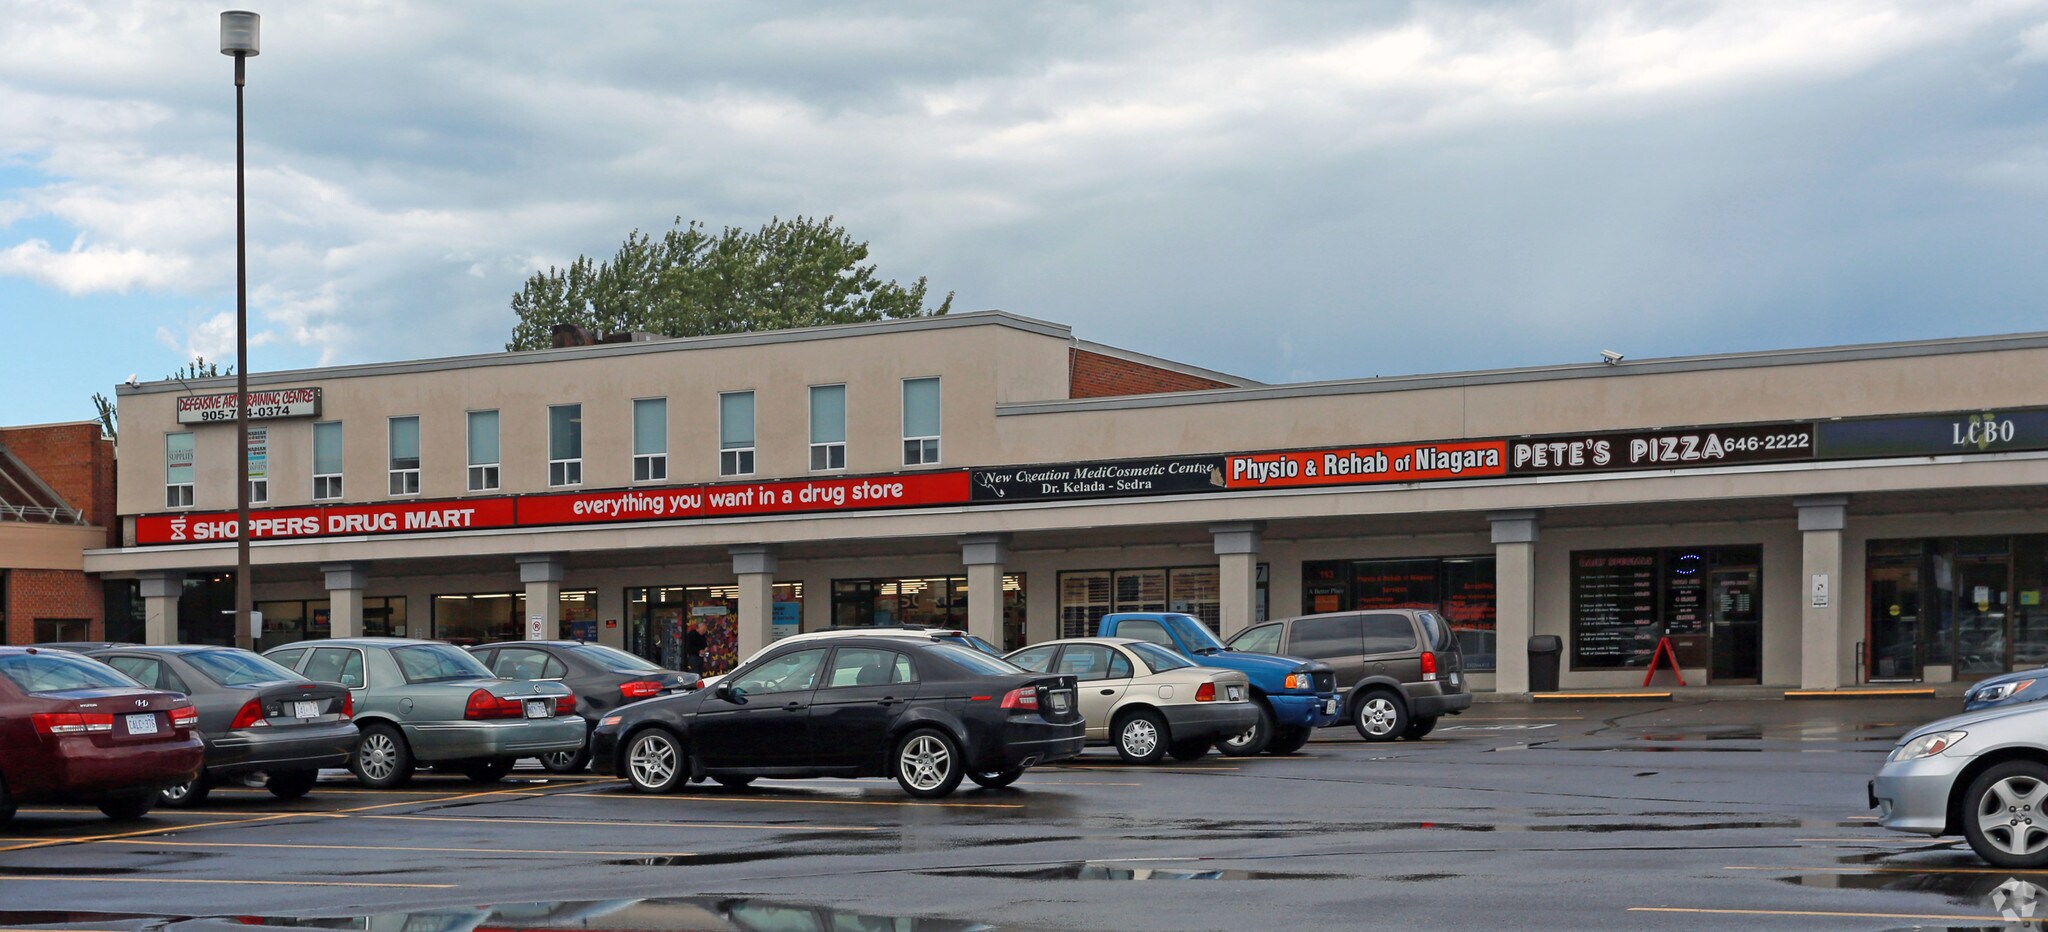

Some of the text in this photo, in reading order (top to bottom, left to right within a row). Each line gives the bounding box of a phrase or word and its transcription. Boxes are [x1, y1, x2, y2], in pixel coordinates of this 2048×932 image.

[179, 389, 313, 412] DEFENSIVE ART RAINING CENTRE
[202, 405, 290, 421] 905-74-0374
[1952, 420, 2014, 445] LCBO
[1514, 433, 1809, 468] PETE'S PIZZA 646-2222
[984, 472, 1012, 485] New
[1073, 463, 1165, 480] MediCosmetic
[1233, 447, 1499, 483] Physio & Rehab of Niagara
[573, 480, 904, 517] everything you want in a drug store
[1042, 482, 1060, 494] Dr.
[1063, 479, 1105, 493] Kelada
[1116, 478, 1152, 490] Sedra
[328, 512, 397, 533] DRUG
[405, 508, 475, 530] MART
